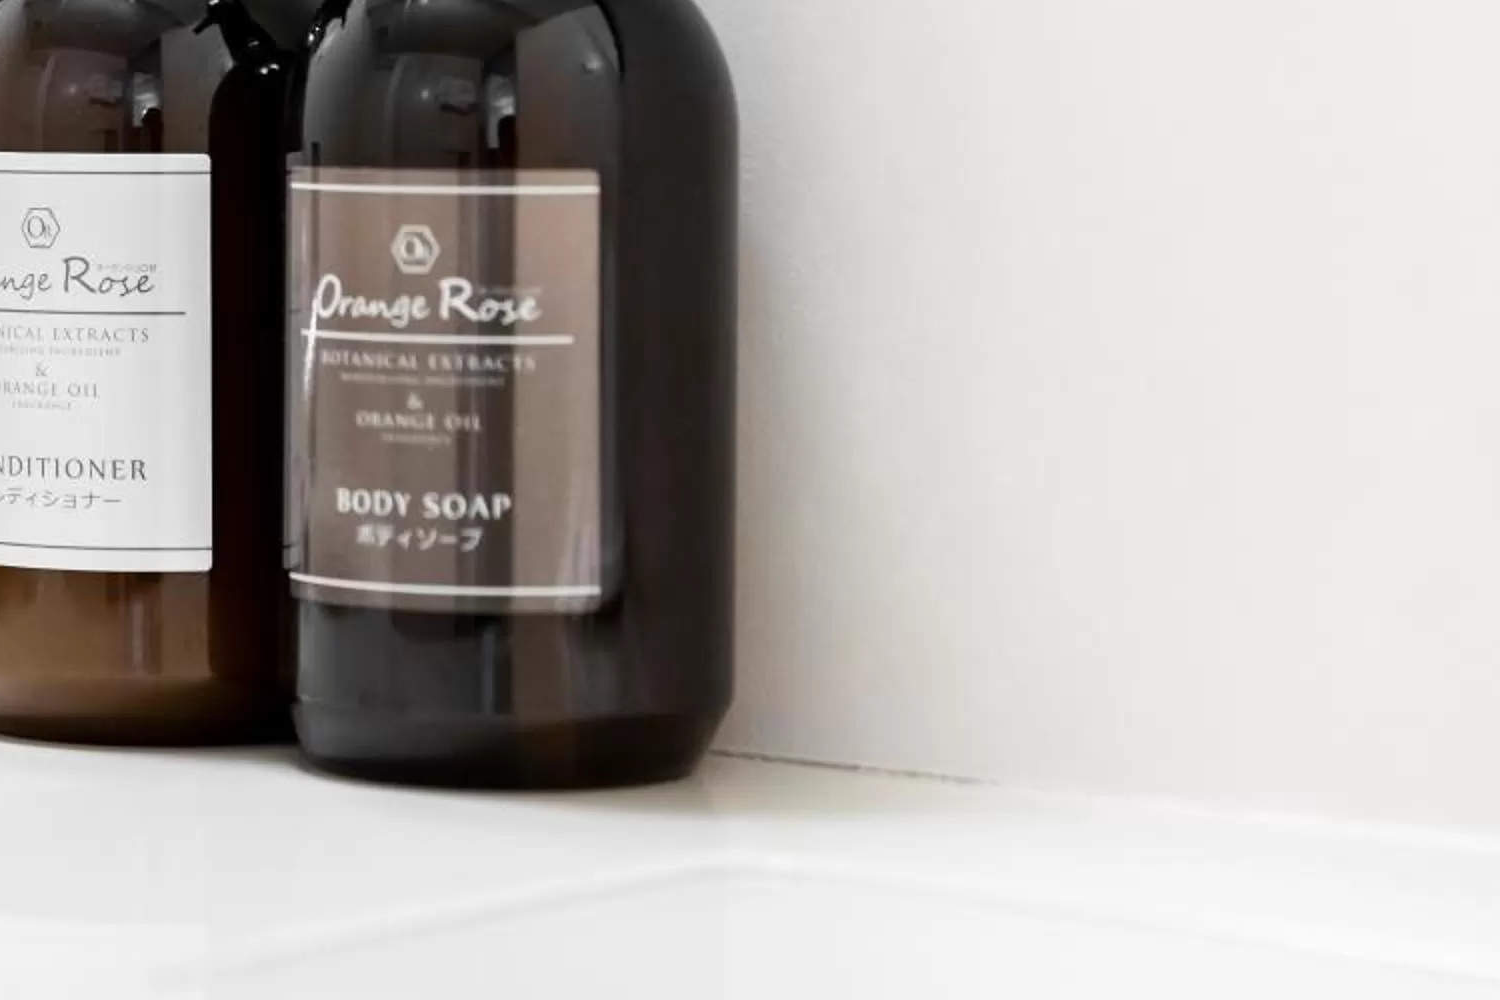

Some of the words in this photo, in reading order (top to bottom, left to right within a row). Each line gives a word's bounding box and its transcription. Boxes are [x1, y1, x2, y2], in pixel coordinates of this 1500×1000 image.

[63, 256, 156, 297] Rose
[314, 274, 431, 328] Orange
[438, 276, 542, 325] Rose
[52, 327, 149, 344] EXTRACTS
[35, 360, 51, 377] &
[321, 349, 419, 371] BOTANICAL
[427, 352, 537, 374] EXTRACTS
[67, 382, 101, 399] OIL
[336, 487, 412, 518] BODY
[422, 491, 512, 521] SOAP
